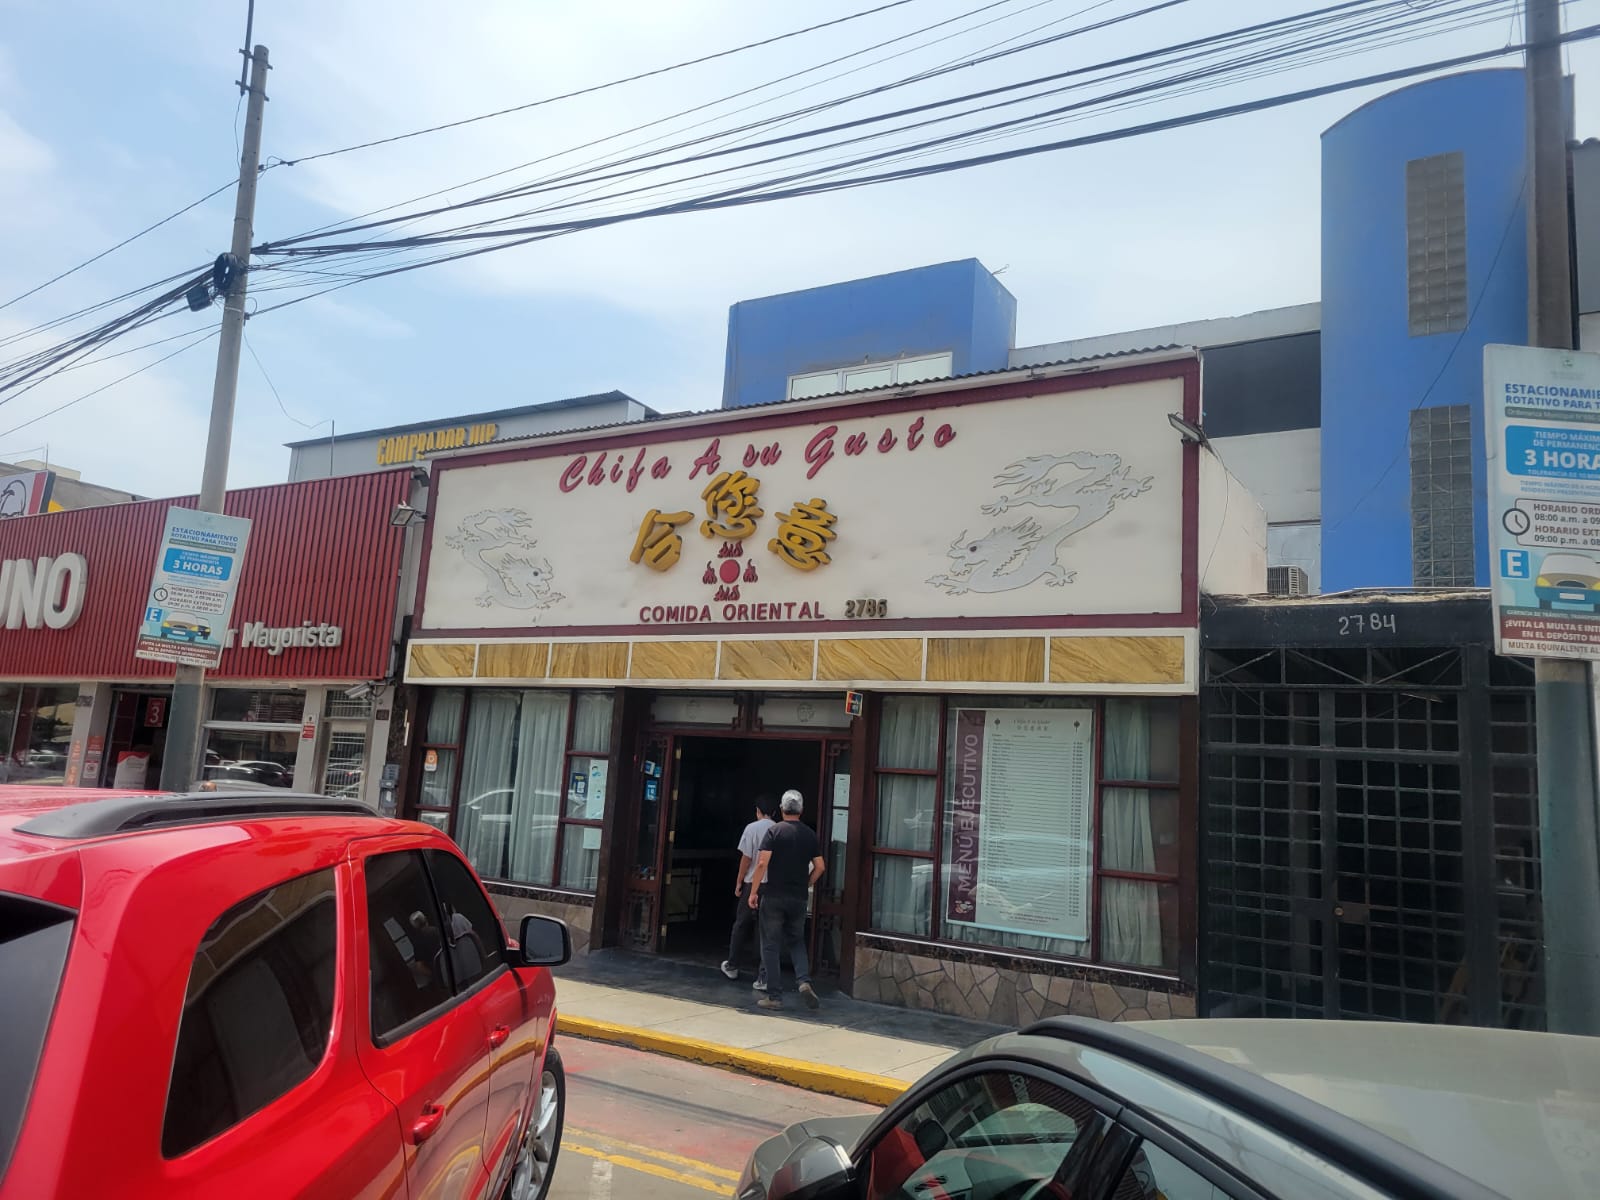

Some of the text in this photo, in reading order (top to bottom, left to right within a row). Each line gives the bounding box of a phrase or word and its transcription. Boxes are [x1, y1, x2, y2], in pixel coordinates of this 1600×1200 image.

[1505, 384, 1600, 399] ESTACIONAMIE
[1506, 395, 1560, 407] ROTATIVO
[1563, 399, 1592, 409] PARA
[1535, 431, 1568, 441] TIEMPO
[1533, 440, 1545, 448] DE
[559, 416, 956, 493] Chifa A su Gusto
[1524, 449, 1600, 470] 3 HORA
[1534, 503, 1578, 514] HORARIO
[1535, 513, 1558, 522] 08:00
[172, 526, 239, 542] ESTACIONAMIENTO
[1535, 525, 1580, 536] HORARIO
[1534, 534, 1558, 543] 09:00
[1561, 537, 1580, 546] p.m.
[173, 559, 180, 569] 3
[183, 562, 223, 575] HORAS
[1506, 551, 1522, 577] E
[150, 608, 159, 621] E
[640, 601, 825, 623] COMIDA ORIENTAL
[1339, 613, 1396, 635] 2784
[1505, 619, 1532, 629] ¡EVITA
[1534, 621, 1545, 629] LA
[1546, 622, 1576, 631] MULTA
[242, 620, 342, 655] Mayorista
[1521, 630, 1533, 638] EN
[1547, 631, 1588, 641] DEPÓSITO
[1508, 641, 1535, 651] MULTA
[1536, 643, 1588, 654] EQUIVALENTE
[150, 706, 159, 724] 3
[957, 835, 974, 892] MENÚ
